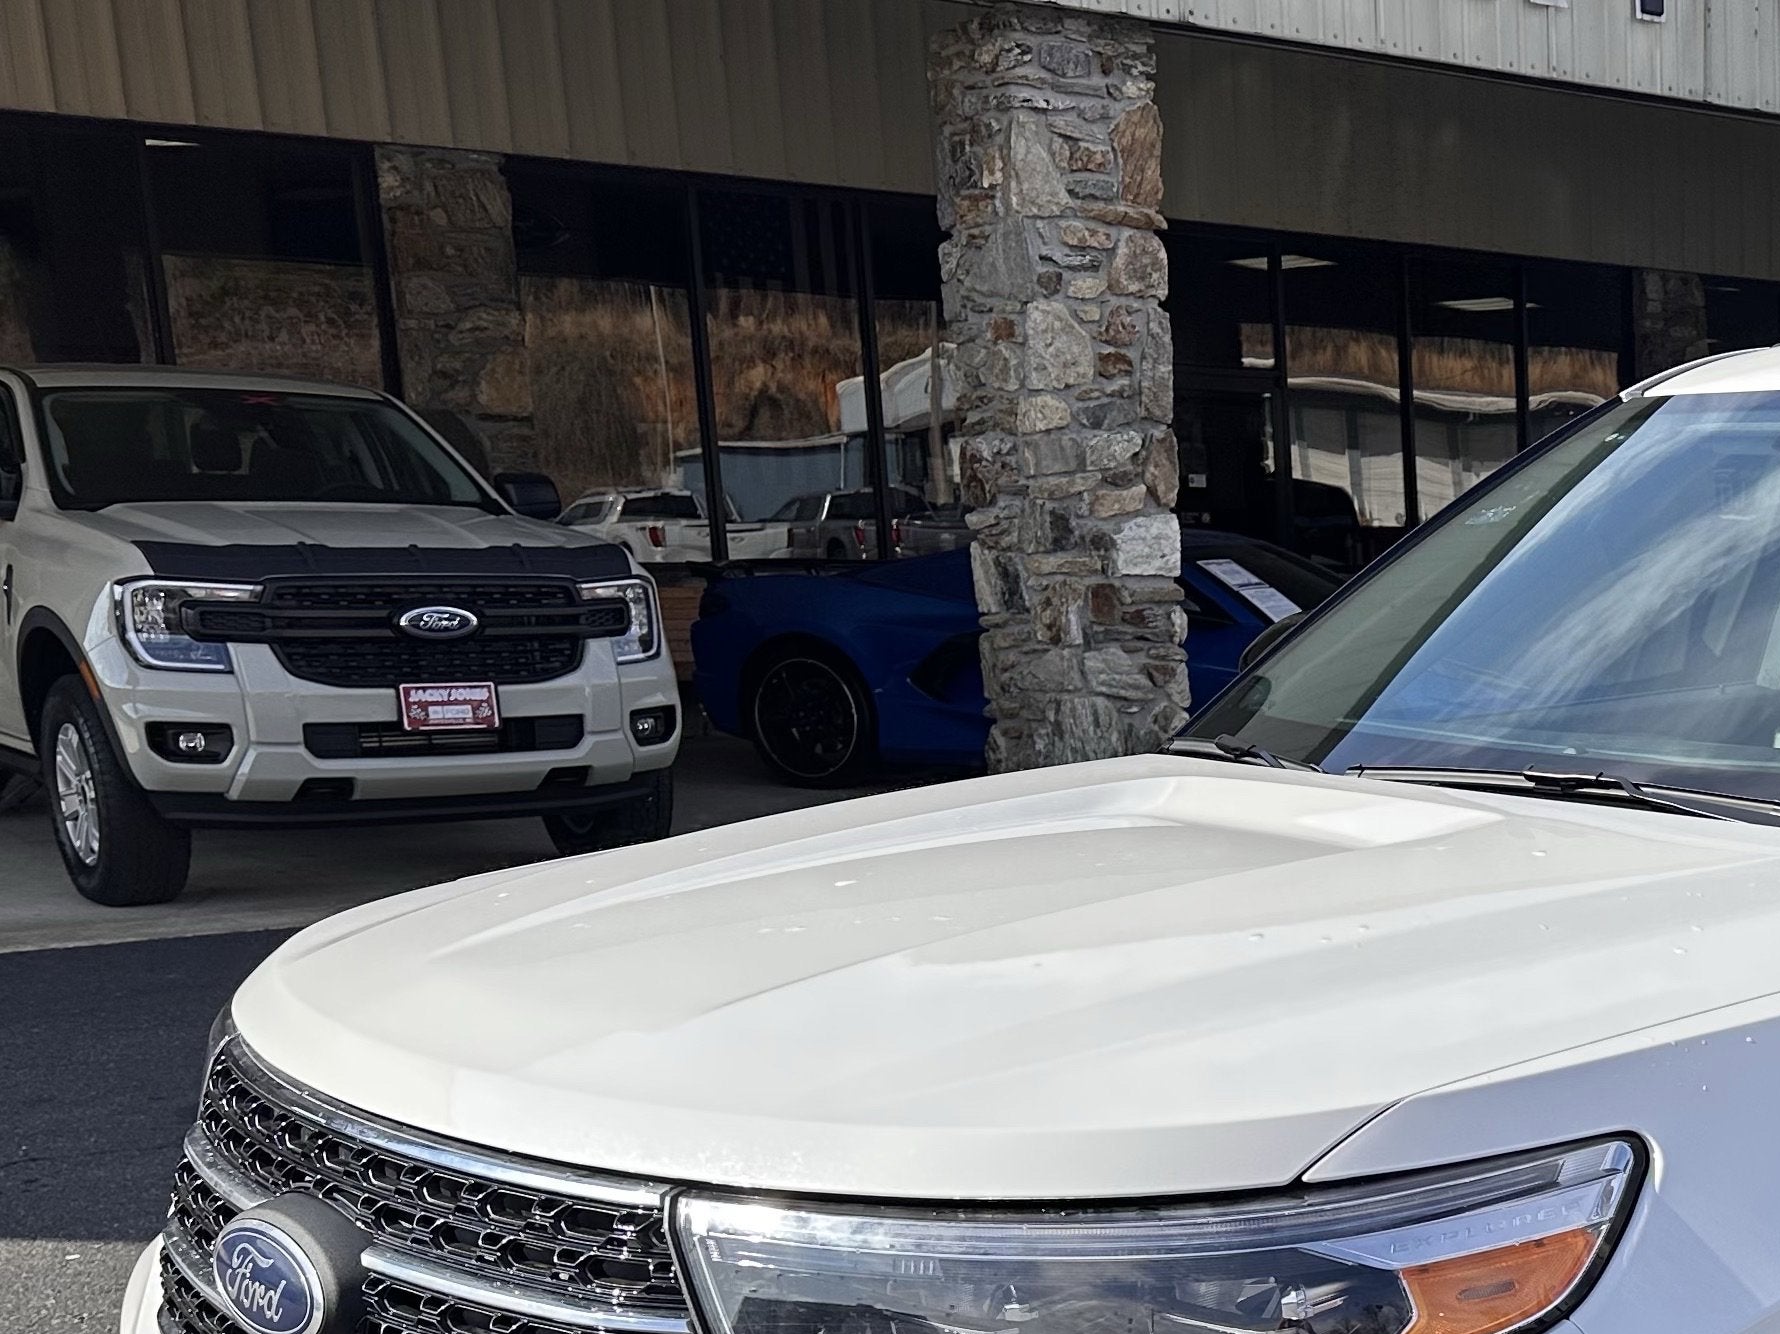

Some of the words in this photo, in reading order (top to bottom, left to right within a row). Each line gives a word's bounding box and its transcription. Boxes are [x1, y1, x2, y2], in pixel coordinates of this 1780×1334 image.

[419, 612, 461, 630] Ford
[1389, 1201, 1581, 1254] EXPLORER
[226, 1243, 286, 1323] Ford
